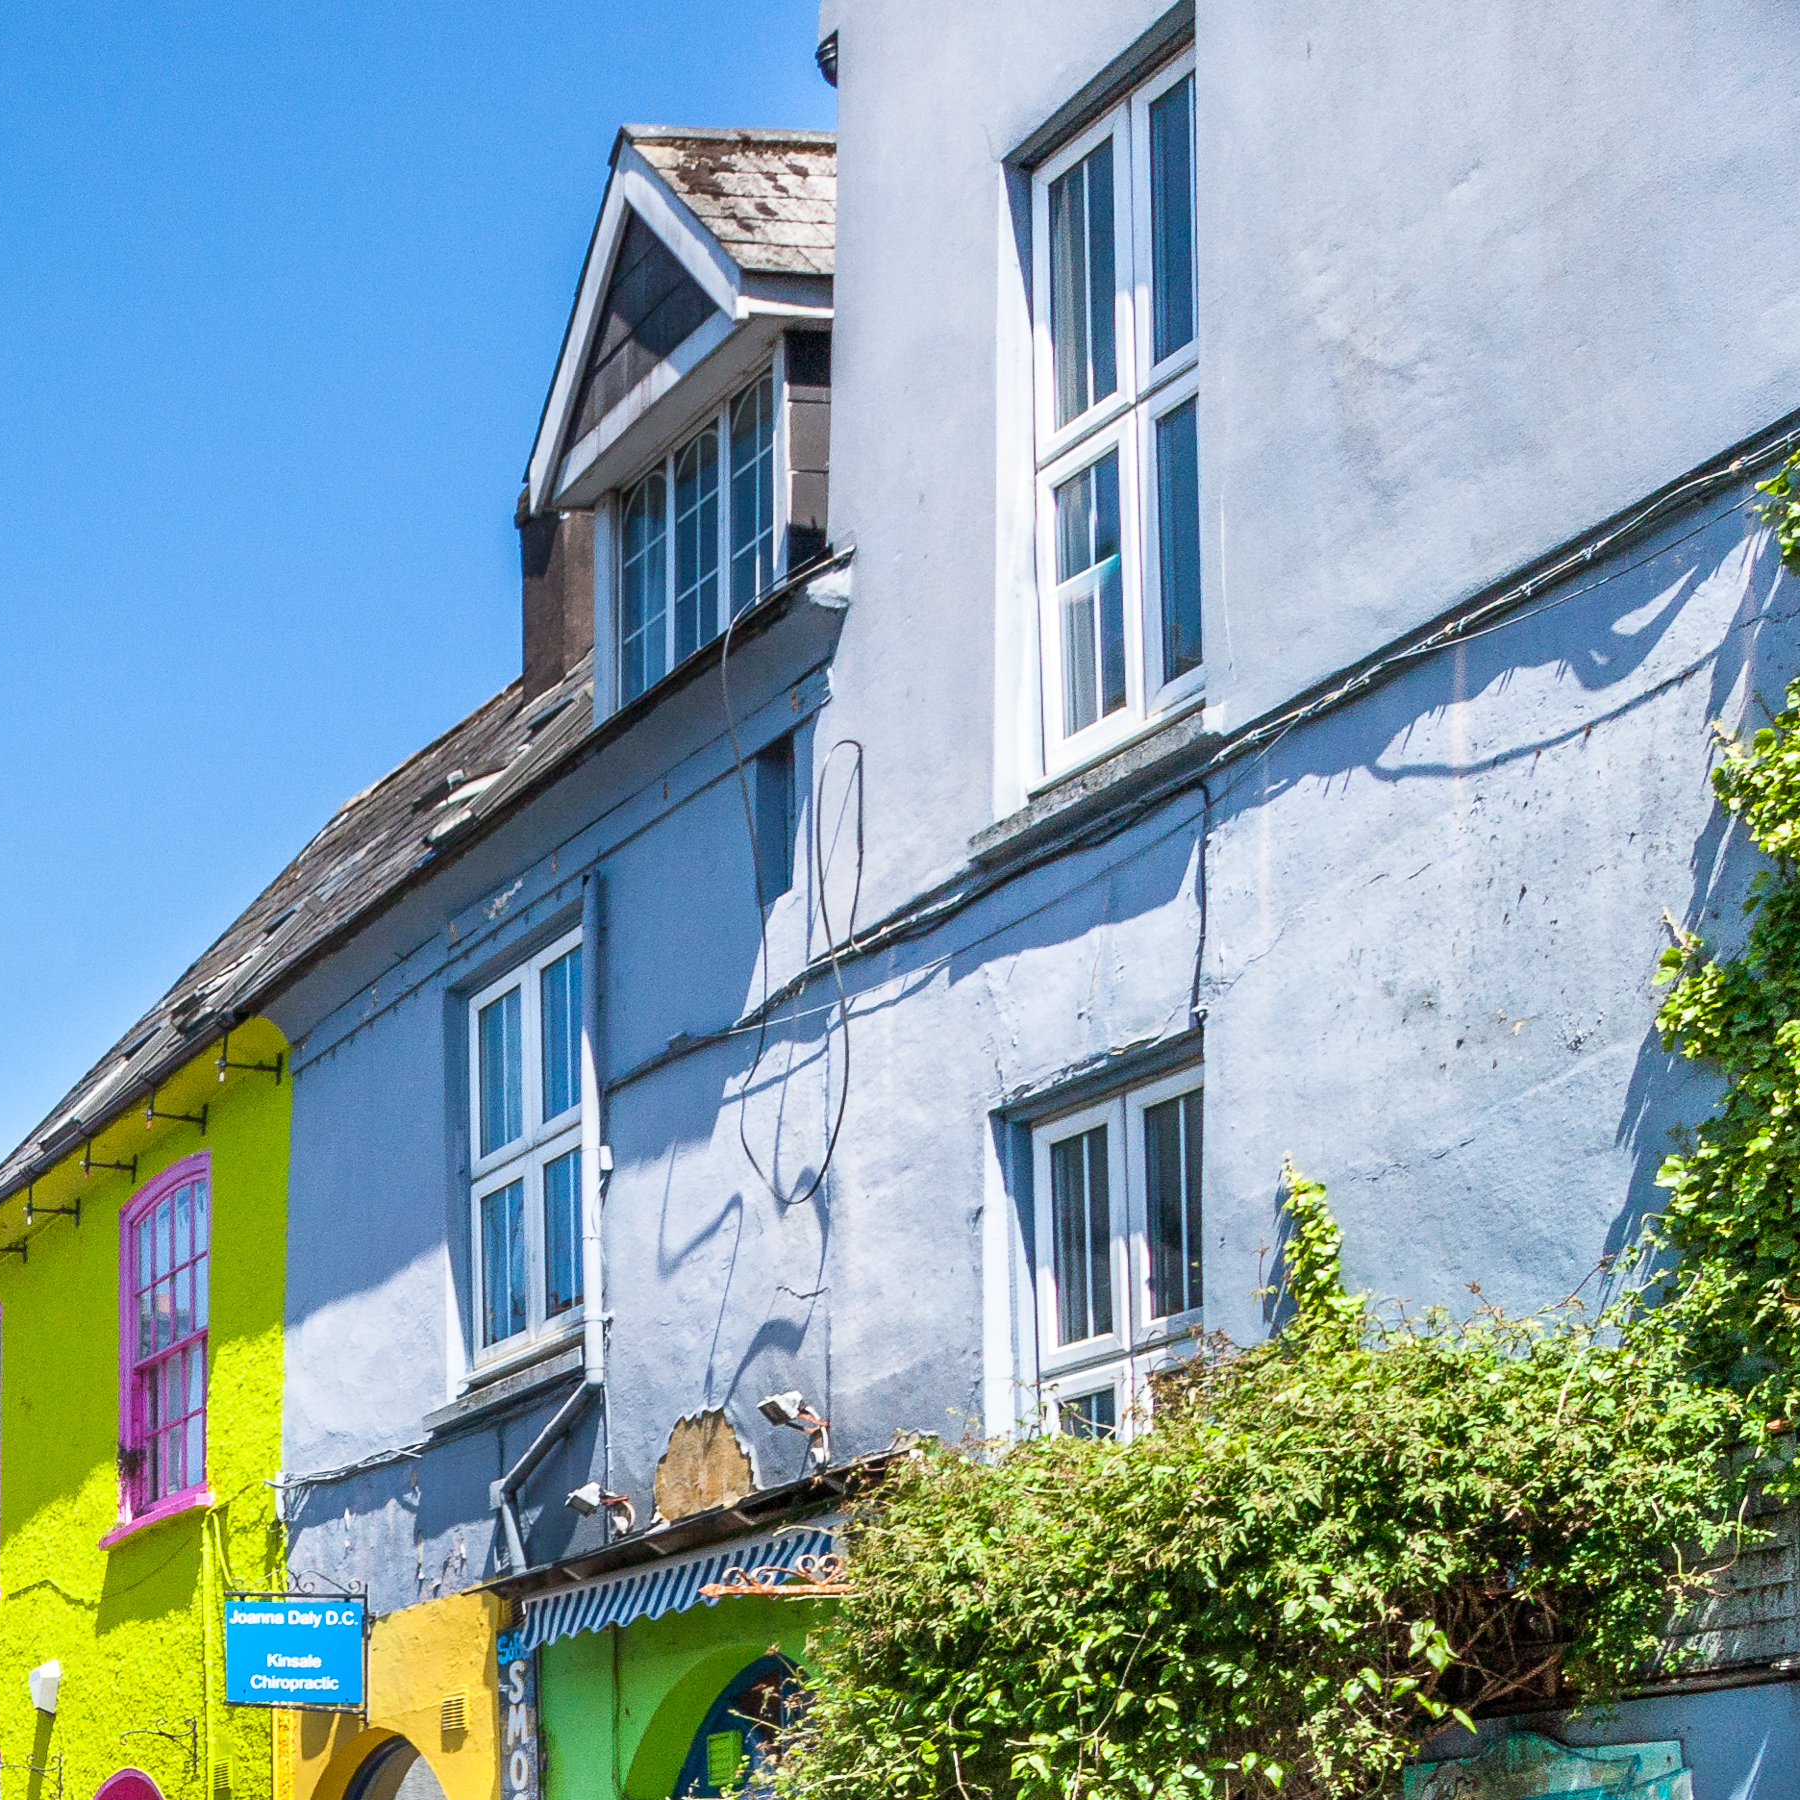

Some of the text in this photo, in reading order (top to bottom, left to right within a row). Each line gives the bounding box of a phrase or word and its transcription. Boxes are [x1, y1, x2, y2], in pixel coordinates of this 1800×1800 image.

[229, 1610, 359, 1628] Joanna Daly D.C.
[267, 1654, 321, 1668] Kinsale
[250, 1675, 339, 1691] Chiropractic
